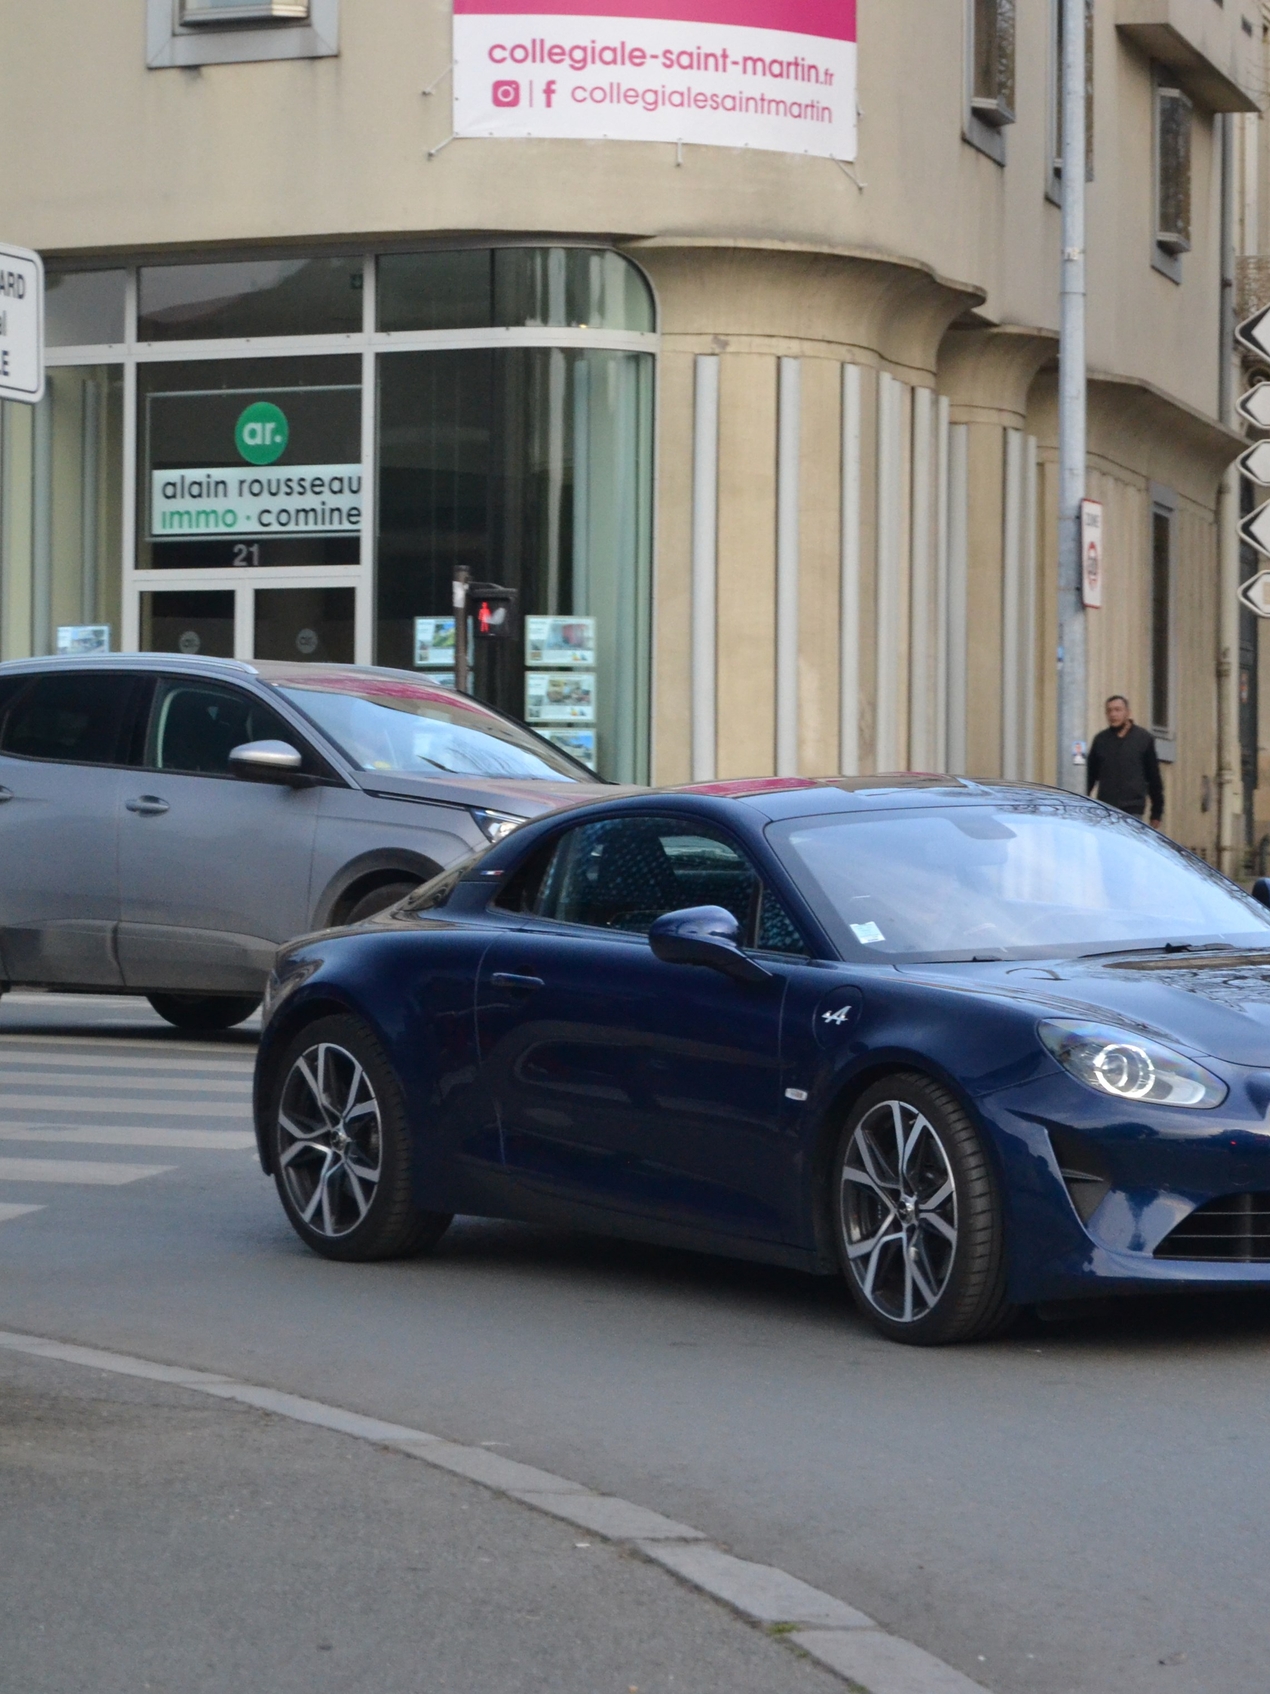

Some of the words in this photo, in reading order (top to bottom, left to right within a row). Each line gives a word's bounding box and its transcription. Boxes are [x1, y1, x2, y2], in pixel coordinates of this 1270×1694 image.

[488, 38, 834, 87] collegiale-saint-martin.fr
[571, 82, 833, 124] collegialesaintmartin
[242, 420, 283, 446] ar.
[162, 475, 228, 500] alain
[238, 474, 361, 498] rousseau
[161, 509, 238, 530] immo
[257, 503, 361, 527] comine
[233, 545, 260, 567] 21
